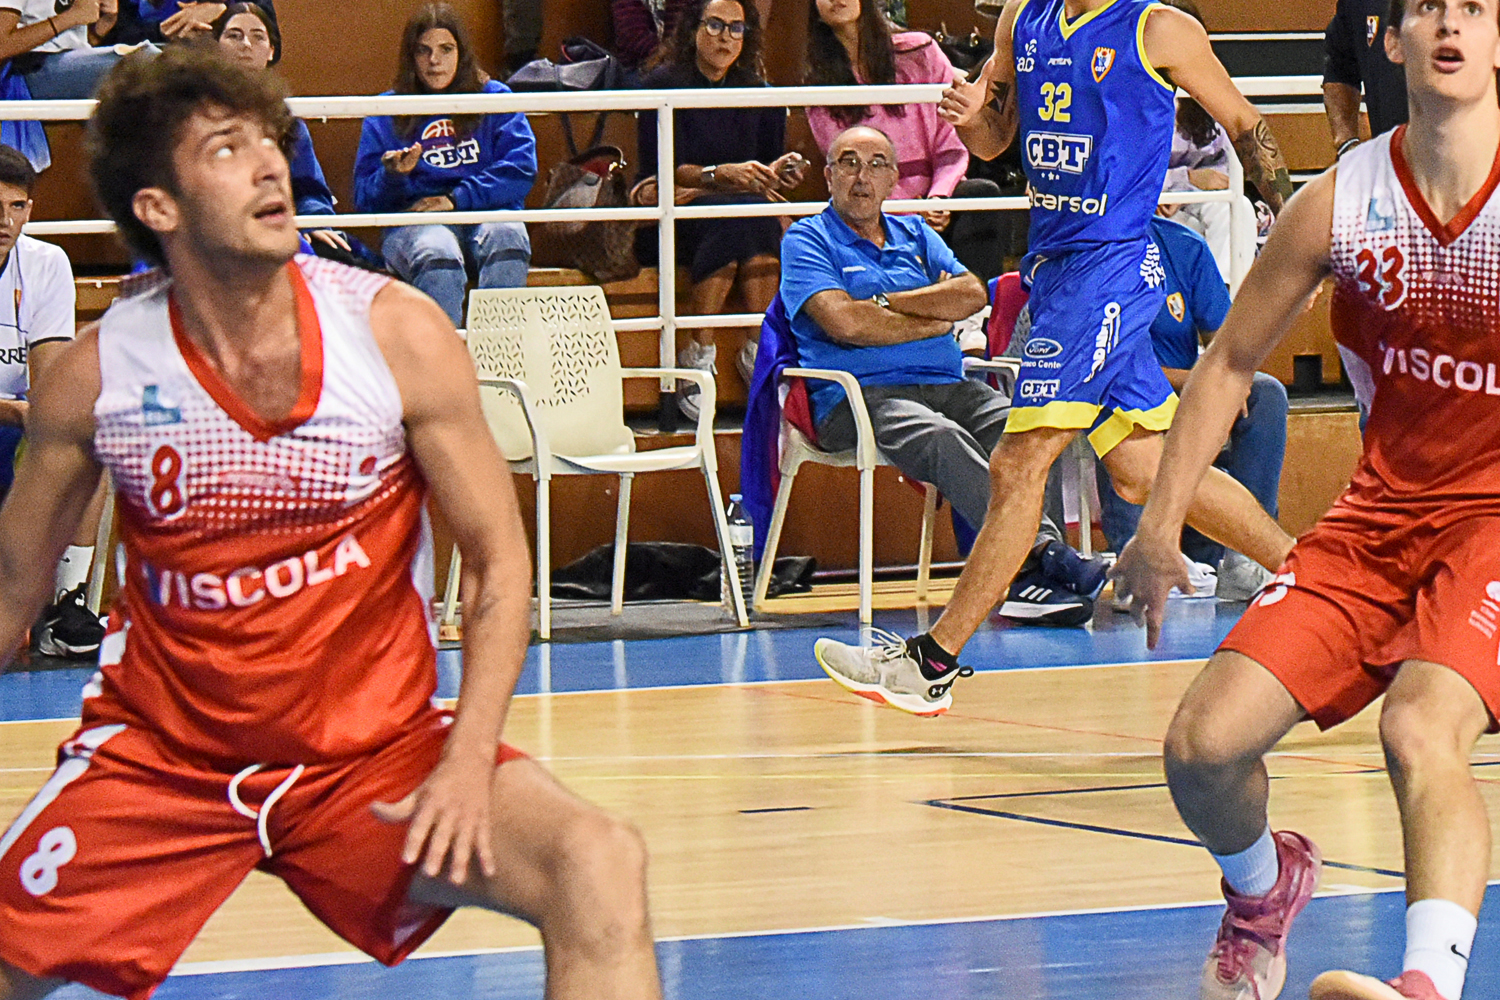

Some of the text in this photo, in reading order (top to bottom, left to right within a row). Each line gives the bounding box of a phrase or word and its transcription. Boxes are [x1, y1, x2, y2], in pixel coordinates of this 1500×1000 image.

[1038, 82, 1072, 123] 32
[421, 137, 480, 169] CBT
[1026, 132, 1091, 173] CBT
[1355, 244, 1409, 311] 33
[148, 443, 187, 520] 8
[143, 534, 371, 610] VISCOLA
[19, 826, 77, 896] 8
